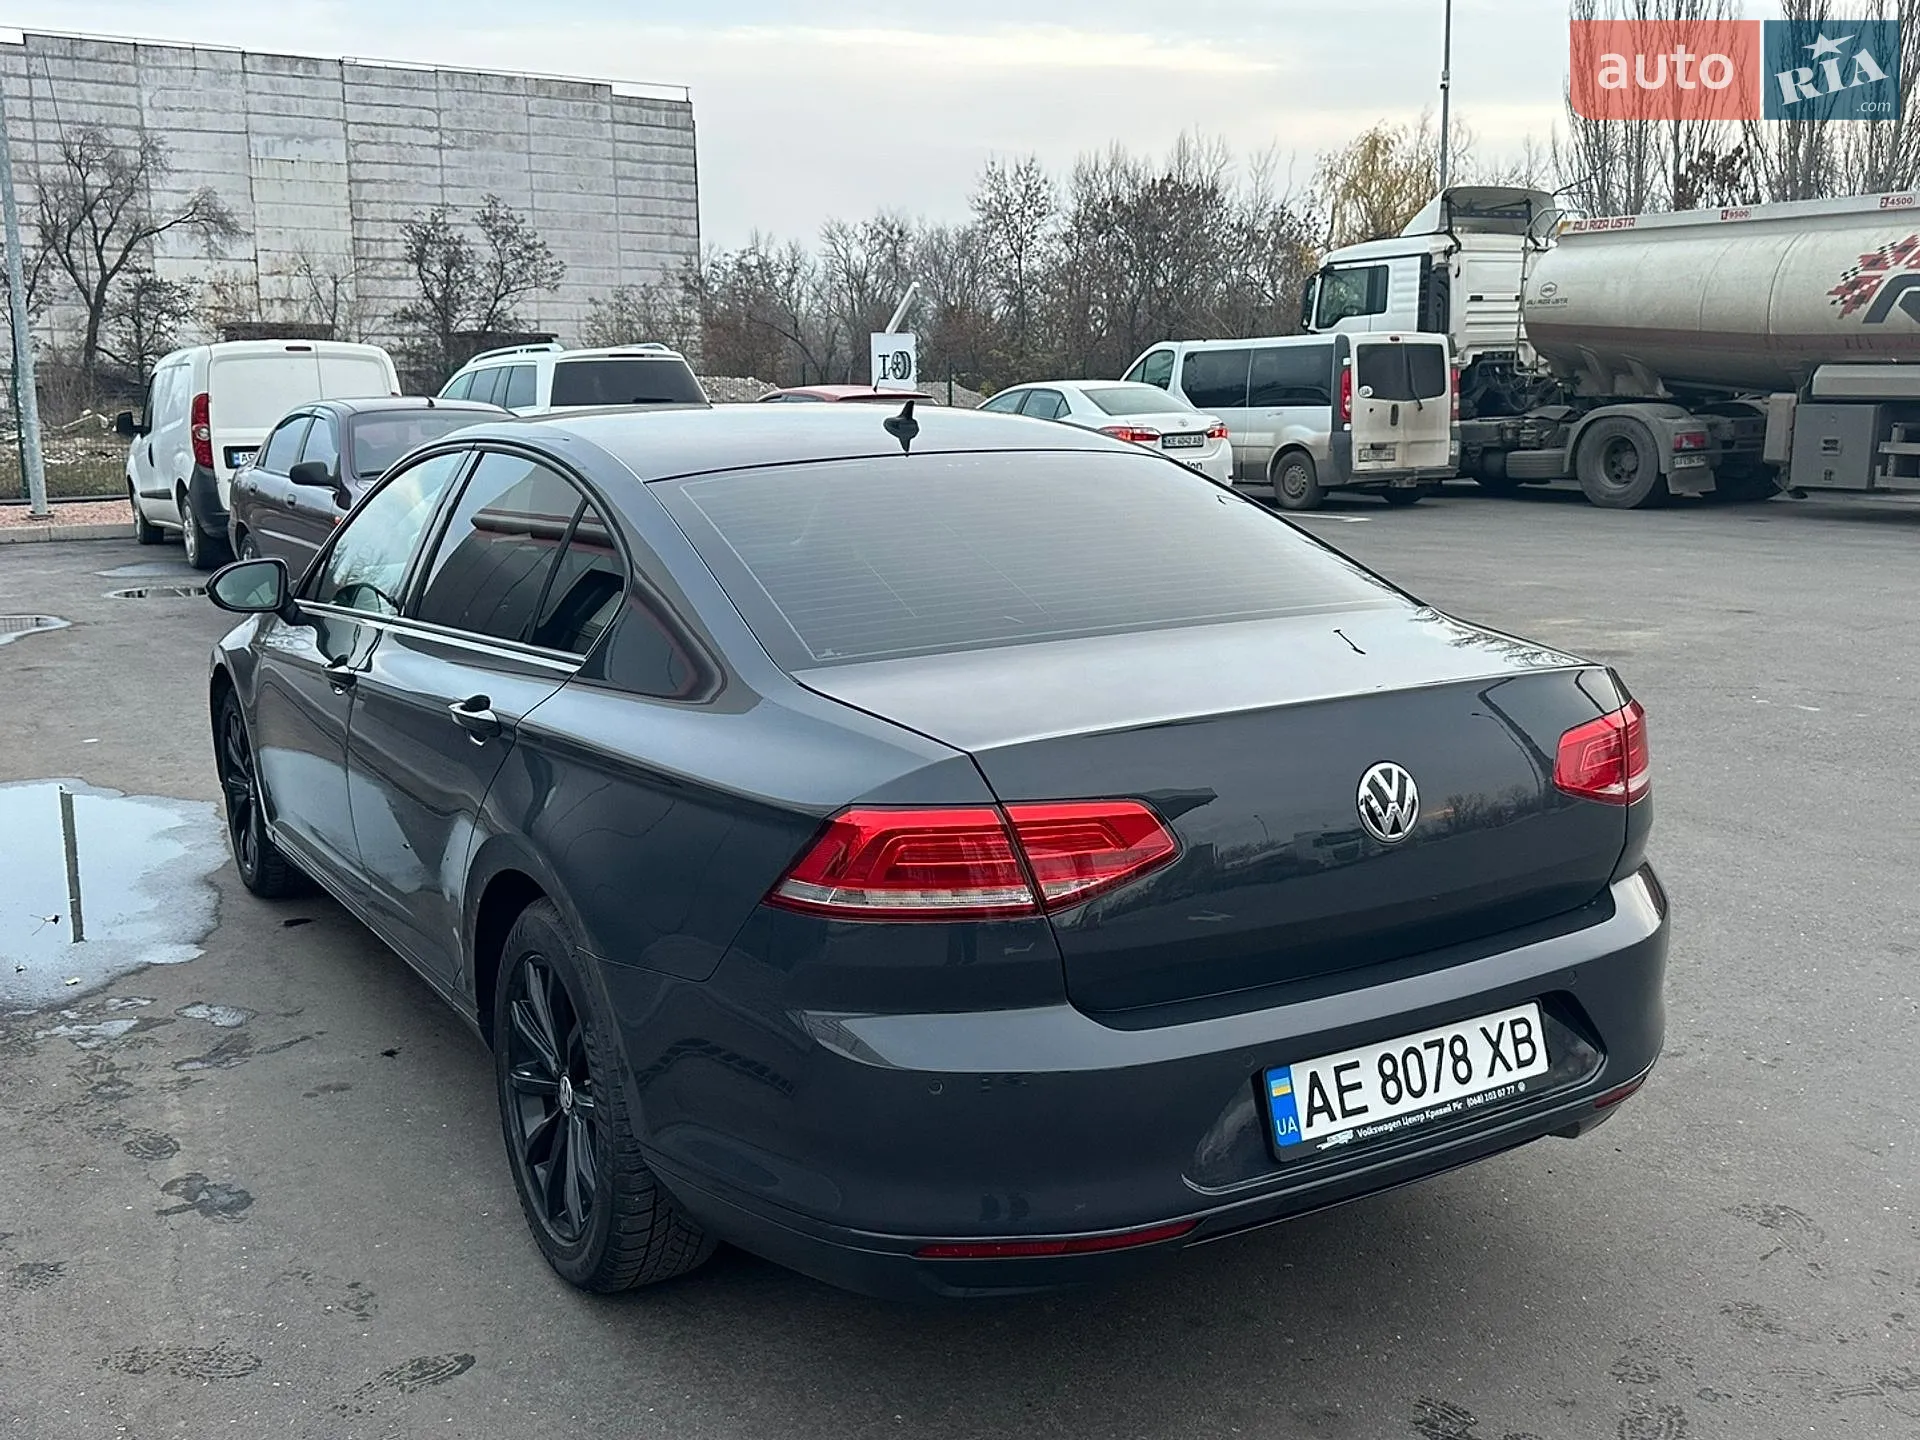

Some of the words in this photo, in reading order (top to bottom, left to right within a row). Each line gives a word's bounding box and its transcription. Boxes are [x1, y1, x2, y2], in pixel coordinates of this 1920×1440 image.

[1889, 197, 1913, 206] 4500
[1729, 211, 1750, 219] 9500
[1589, 219, 1609, 230] RIZA
[1610, 217, 1636, 229] USTA
[1305, 1061, 1369, 1128] AE
[1377, 1034, 1473, 1105] 8078
[1480, 1016, 1537, 1078] XB
[1357, 1120, 1401, 1138] Volkswagen
[1402, 1113, 1425, 1127] Центр
[1484, 1090, 1496, 1102] 103
[1506, 1085, 1515, 1095] 77
[1277, 1117, 1298, 1136] UA
